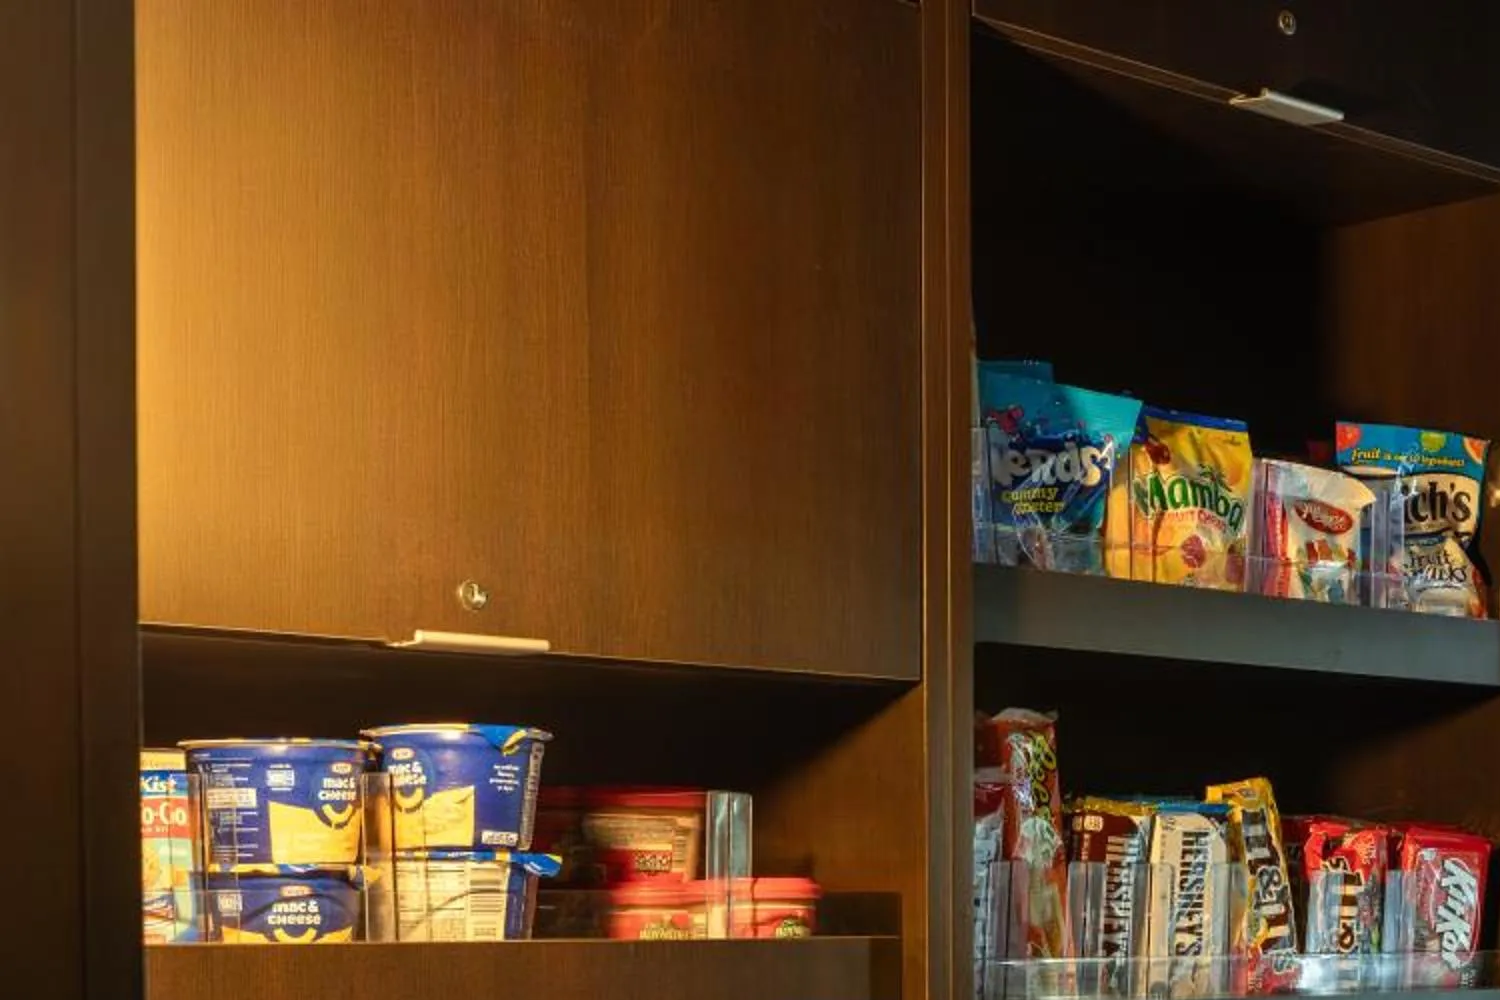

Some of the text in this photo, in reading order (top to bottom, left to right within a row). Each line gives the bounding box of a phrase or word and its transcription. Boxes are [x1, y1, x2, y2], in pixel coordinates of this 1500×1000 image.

[1133, 472, 1243, 532] Mambo
[1403, 482, 1471, 523] lch's
[140, 776, 177, 793] Kist
[141, 802, 187, 824] o-Go
[1176, 830, 1210, 957] HERSHEY'S
